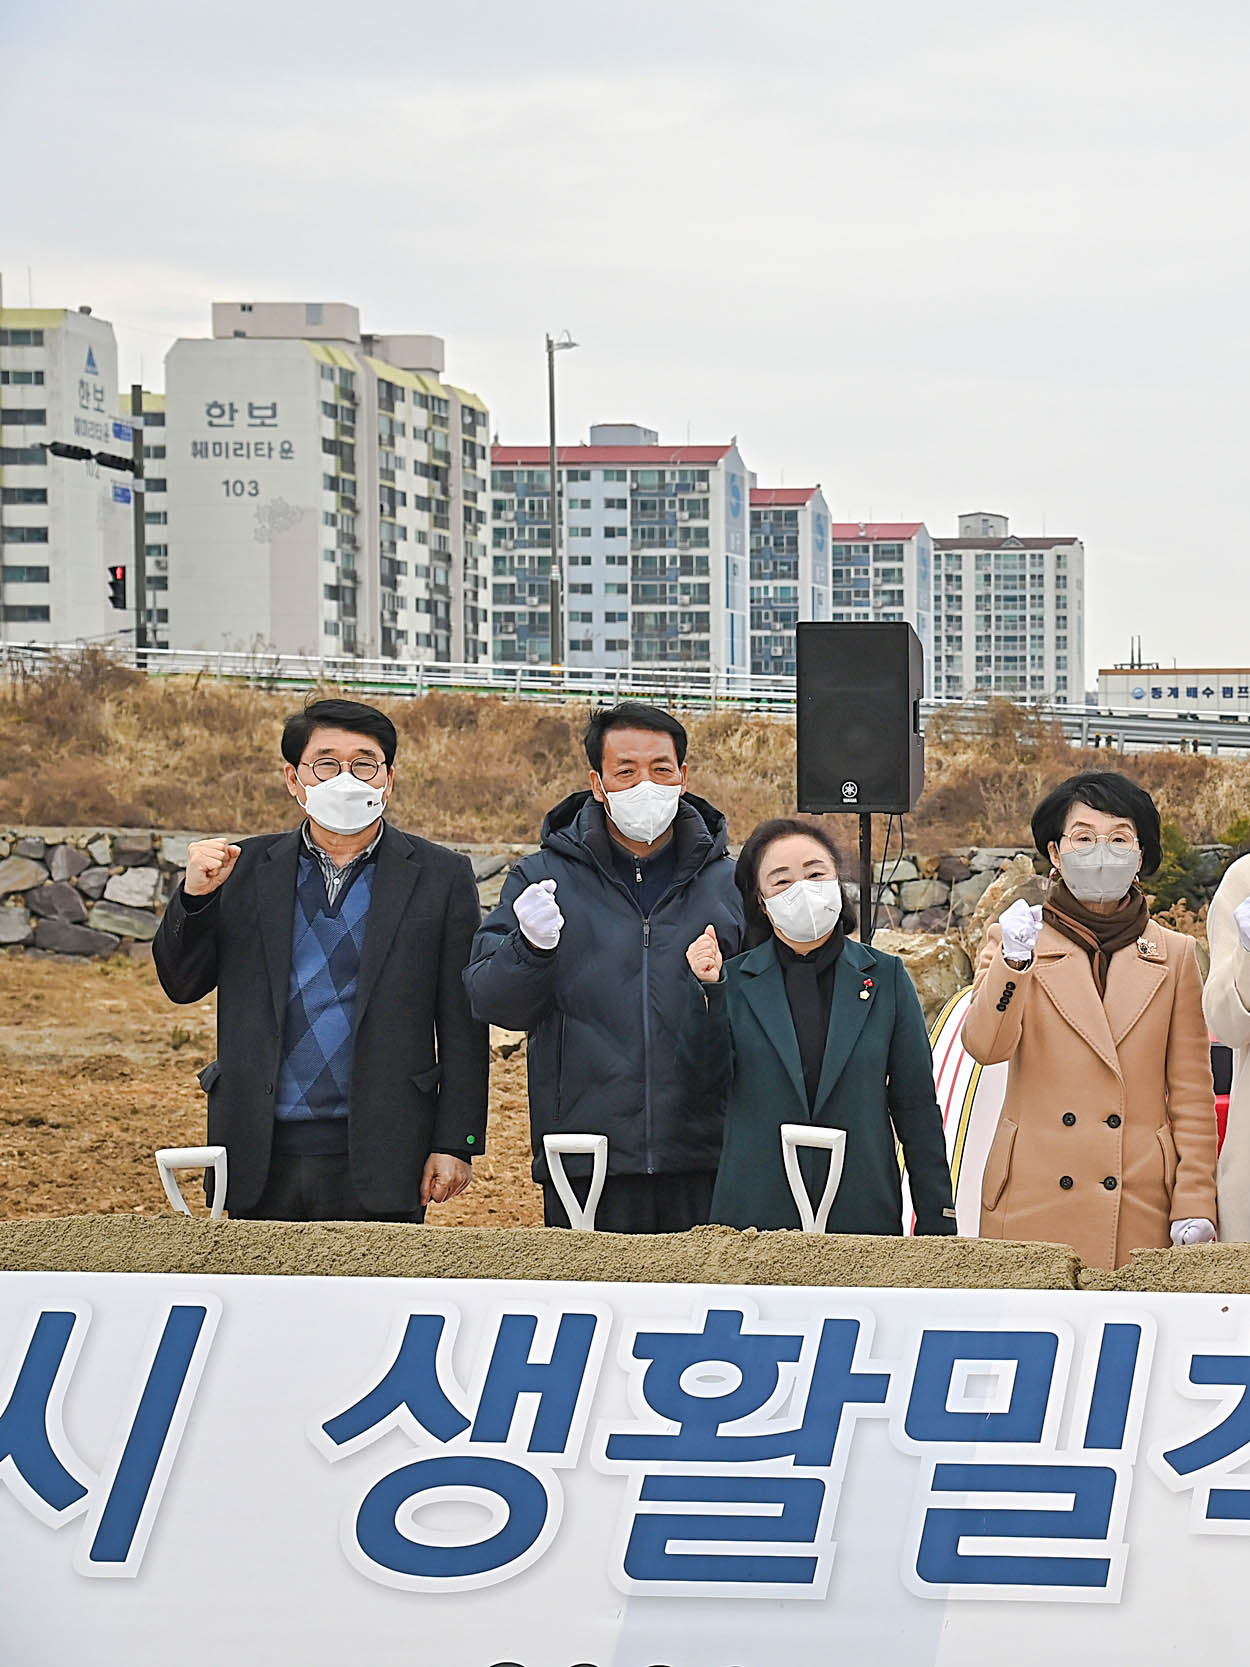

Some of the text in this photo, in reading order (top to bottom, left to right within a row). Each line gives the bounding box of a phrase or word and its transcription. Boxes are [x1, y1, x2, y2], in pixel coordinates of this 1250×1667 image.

[78, 378, 105, 413] 한보
[205, 400, 278, 428] 한보
[222, 479, 259, 497] 103
[0, 1305, 208, 1563] 시
